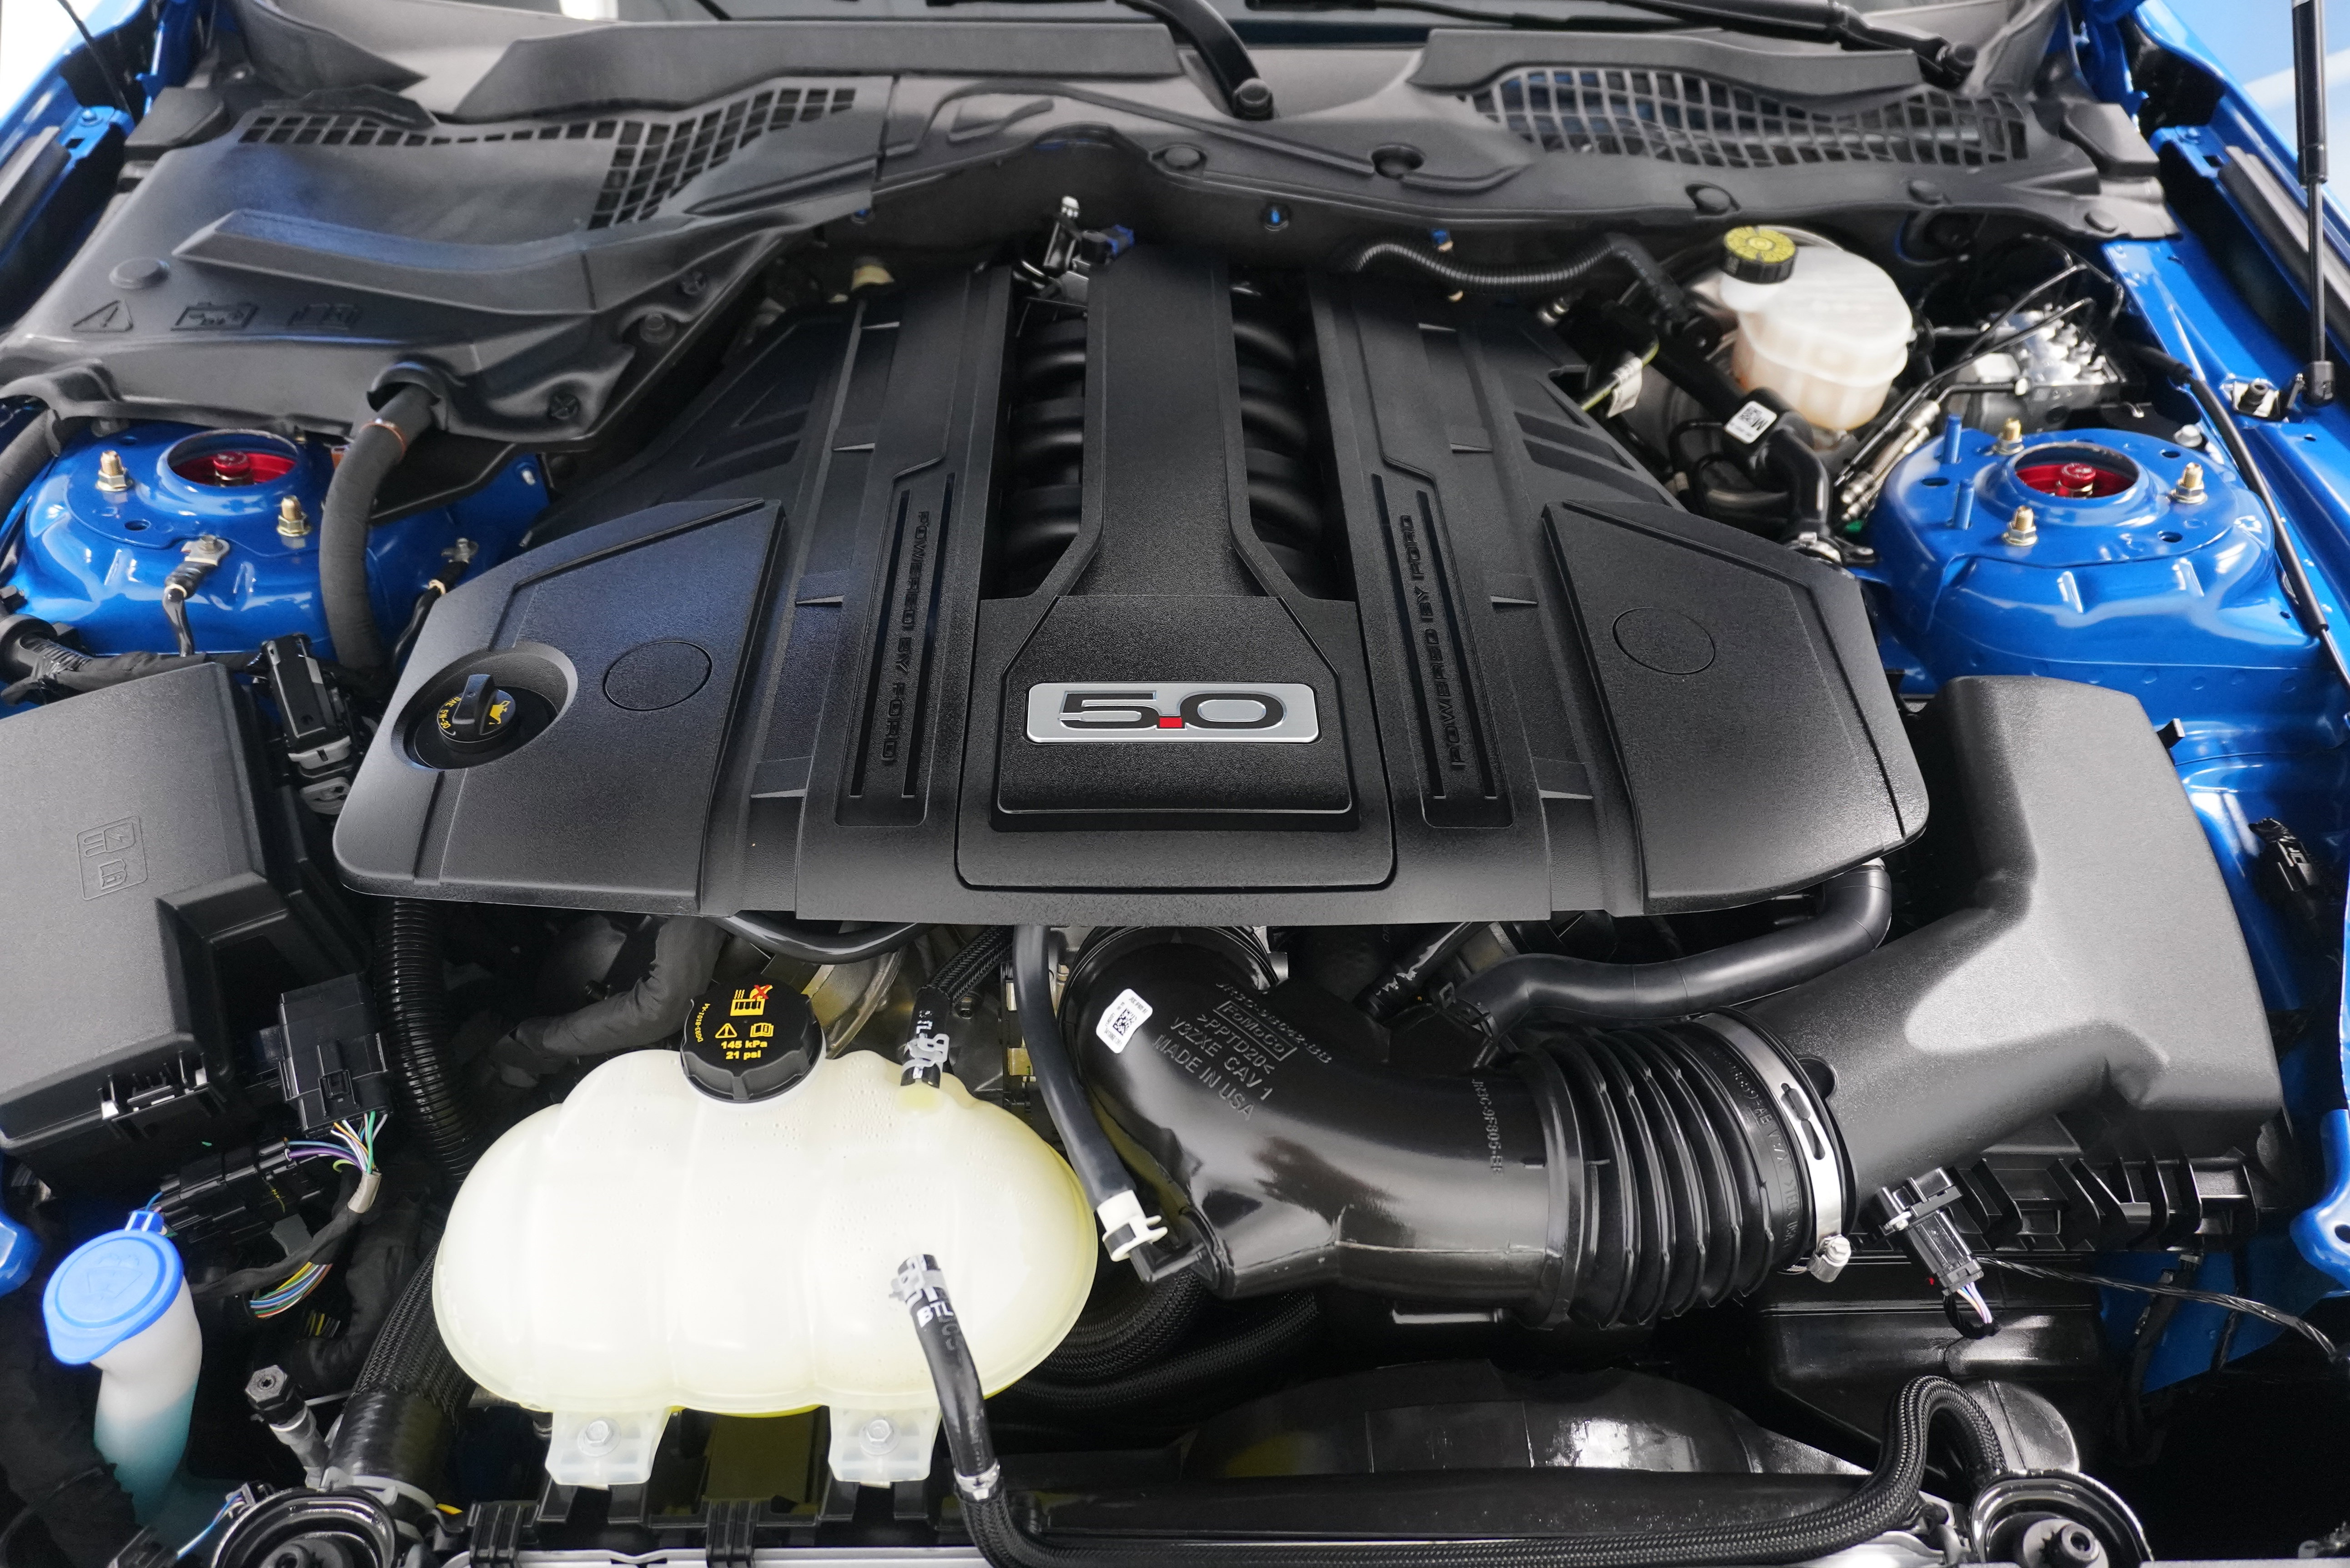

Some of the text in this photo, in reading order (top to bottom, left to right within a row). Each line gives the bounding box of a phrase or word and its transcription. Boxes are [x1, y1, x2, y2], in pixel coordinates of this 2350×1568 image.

[881, 510, 930, 762] POWERED BY FORD
[1399, 514, 1466, 767] POWERED BY FORD
[445, 696, 462, 707] SAE
[1059, 690, 1287, 730] 5.0
[721, 1039, 768, 1050] 145 kPa
[1221, 1002, 1286, 1055] FoMoCo
[725, 1049, 762, 1060] 21 psi
[1224, 1056, 1263, 1088] CAV
[1151, 1033, 1198, 1074] MADE
[1199, 1066, 1222, 1089] IN
[1219, 1084, 1255, 1121] USA
